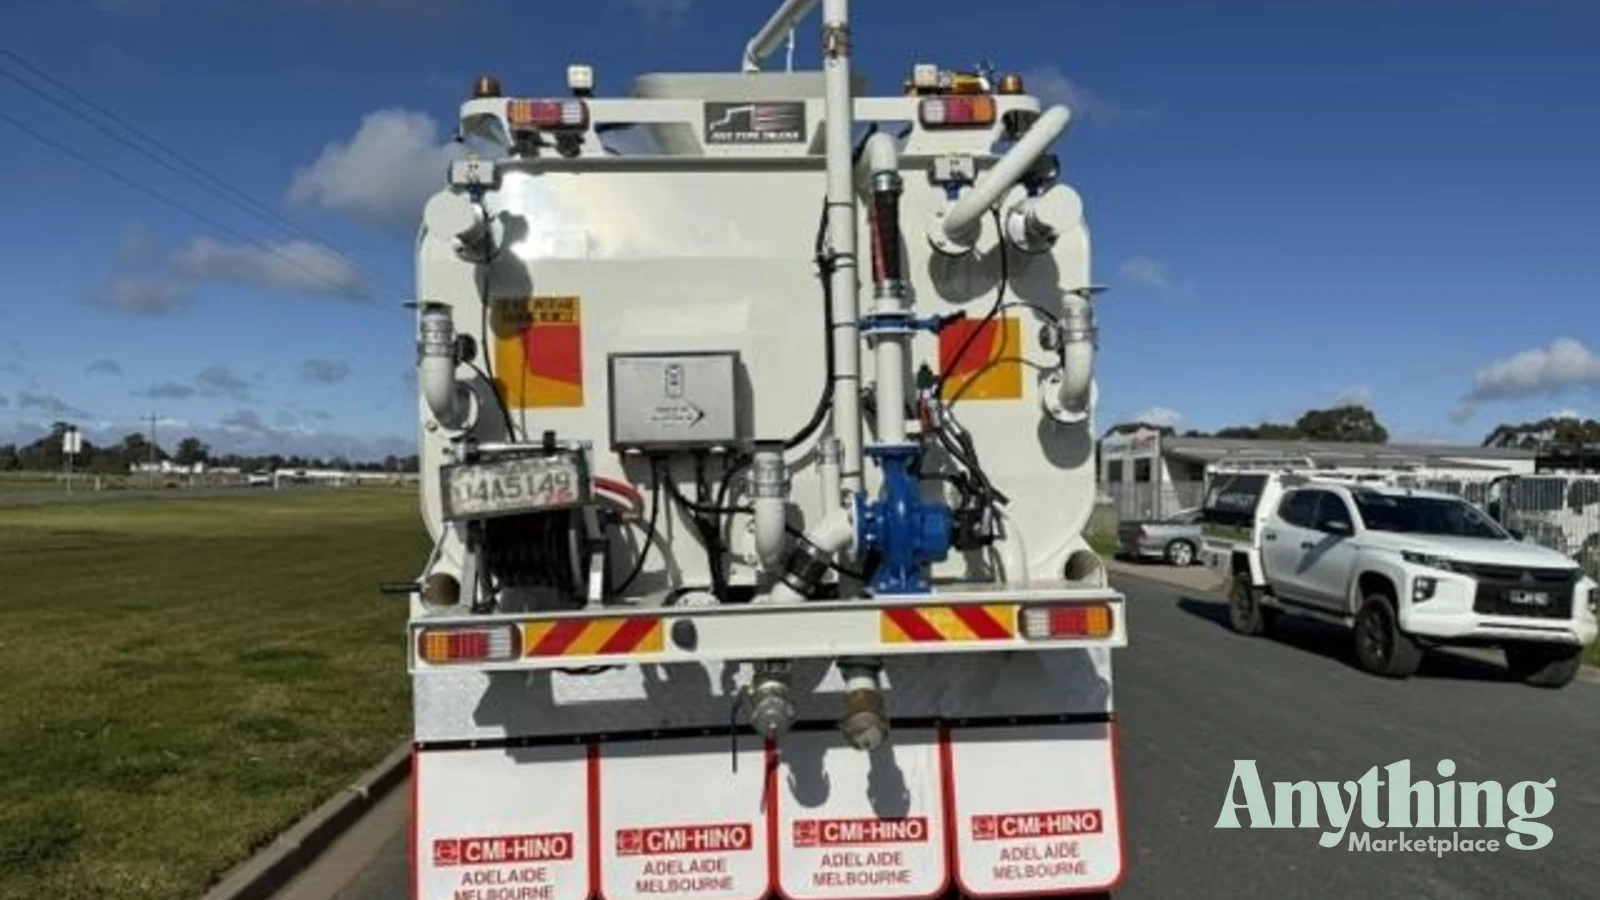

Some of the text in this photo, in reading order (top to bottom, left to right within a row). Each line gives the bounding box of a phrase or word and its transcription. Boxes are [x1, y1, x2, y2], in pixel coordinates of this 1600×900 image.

[824, 820, 923, 841] CMI-HINO
[1001, 813, 1098, 836] CMI-HINO
[647, 827, 747, 851] CMI-HINO
[465, 837, 568, 861] CMI-HINO
[1000, 842, 1081, 861] ADELAIDE
[643, 858, 727, 875] ADELAIDE
[820, 852, 904, 868] ADELAIDE
[461, 867, 547, 886] ADELAIDE
[813, 870, 911, 887] MELBOURNE
[993, 861, 1089, 880] MELBOURNE
[636, 876, 733, 893] MELBOURNE
